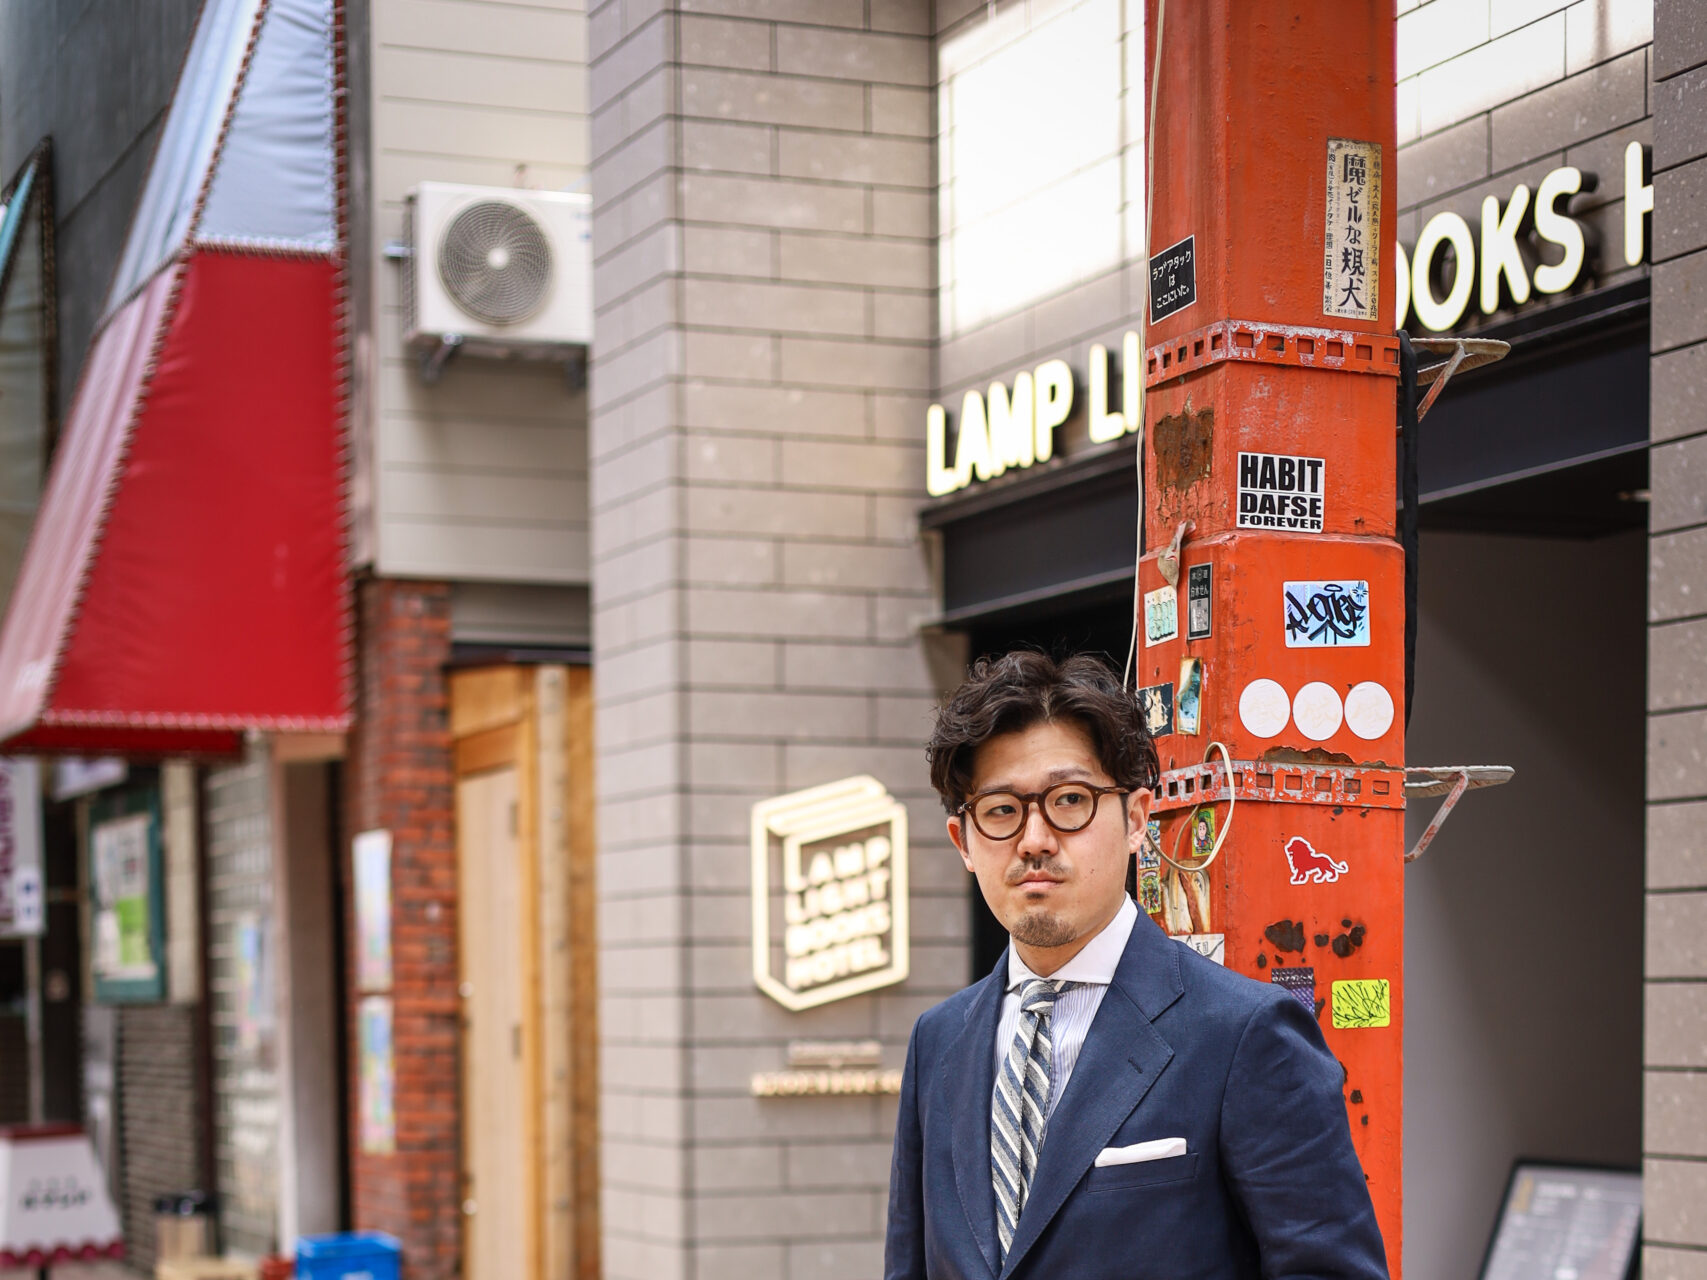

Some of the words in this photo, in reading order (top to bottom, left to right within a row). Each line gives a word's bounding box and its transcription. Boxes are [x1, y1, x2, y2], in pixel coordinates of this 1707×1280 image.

[1338, 153, 1367, 310] 魔ゼルな規犬
[1152, 250, 1192, 281] ラブアタック
[1168, 273, 1176, 288] は
[1156, 284, 1190, 309] ここにいた。
[927, 359, 1074, 497] LAMP
[1396, 166, 1585, 332] OKS
[1240, 454, 1323, 493] HABIT
[1240, 492, 1322, 518] DAFSE
[1239, 514, 1322, 530] FOREVER
